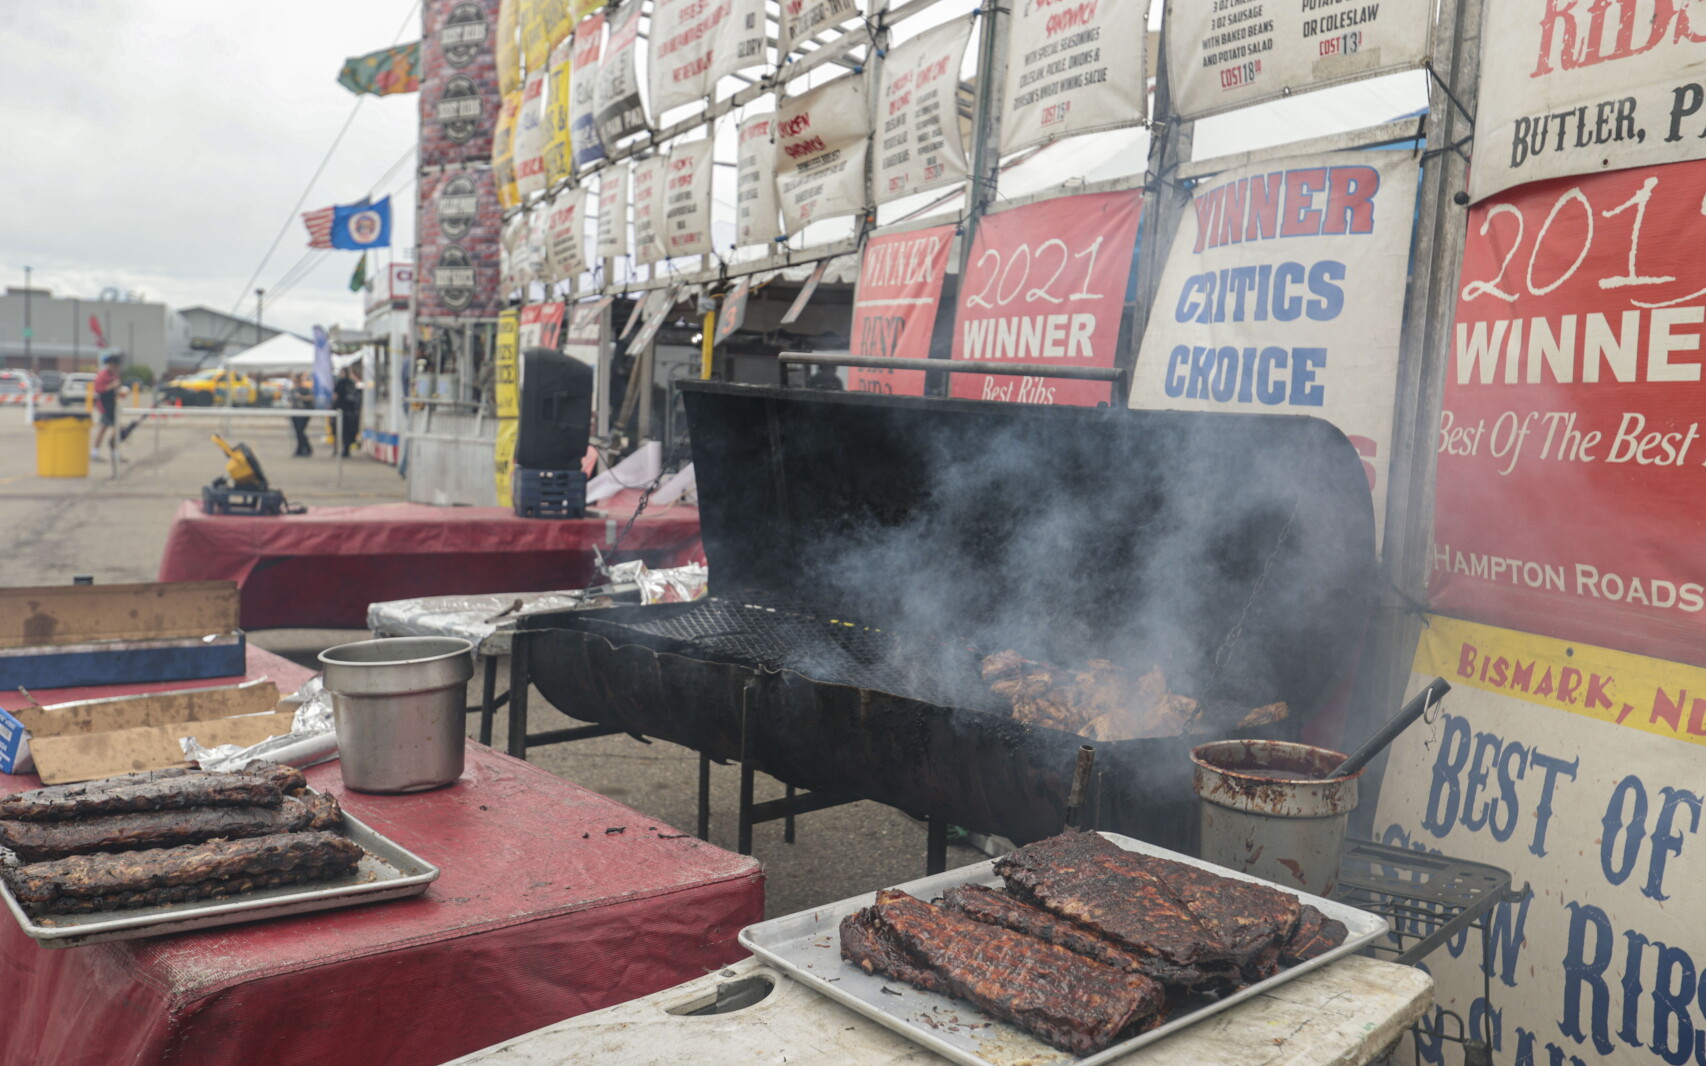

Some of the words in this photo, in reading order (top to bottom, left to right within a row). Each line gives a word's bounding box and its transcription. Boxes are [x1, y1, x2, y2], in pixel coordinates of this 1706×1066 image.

[1202, 33, 1221, 51] WITH
[1221, 27, 1246, 48] BAKED
[1247, 19, 1274, 38] BEANS
[1217, 16, 1226, 29] OZ
[1228, 5, 1263, 26] SAUSAGE
[1303, 19, 1318, 38] OR
[1320, 3, 1380, 33] COLESLAW
[1203, 53, 1218, 68] AND
[1219, 44, 1246, 64] POTATO
[1247, 38, 1273, 57] SALAD
[1509, 96, 1646, 169] BUTLER,
[1664, 83, 1706, 143] P
[864, 237, 941, 288] WINNER
[967, 236, 1104, 308] 2021
[1462, 177, 1706, 308] 201
[1175, 260, 1346, 325] CRITICS
[962, 313, 1096, 359] WINNER
[1456, 306, 1706, 385] WINNE
[982, 376, 1014, 401] Best
[1017, 376, 1056, 405] Ribs
[1437, 410, 1485, 456] Best
[1490, 411, 1539, 475] Of
[1539, 412, 1602, 462] The
[1605, 412, 1700, 466] Best
[1433, 543, 1566, 592] HAMPTON
[1575, 562, 1705, 612] ROADS
[1456, 642, 1635, 725] BISMARK,
[1421, 713, 1580, 858] BEST
[1600, 775, 1705, 902] OF
[1557, 900, 1706, 1066] RIB
